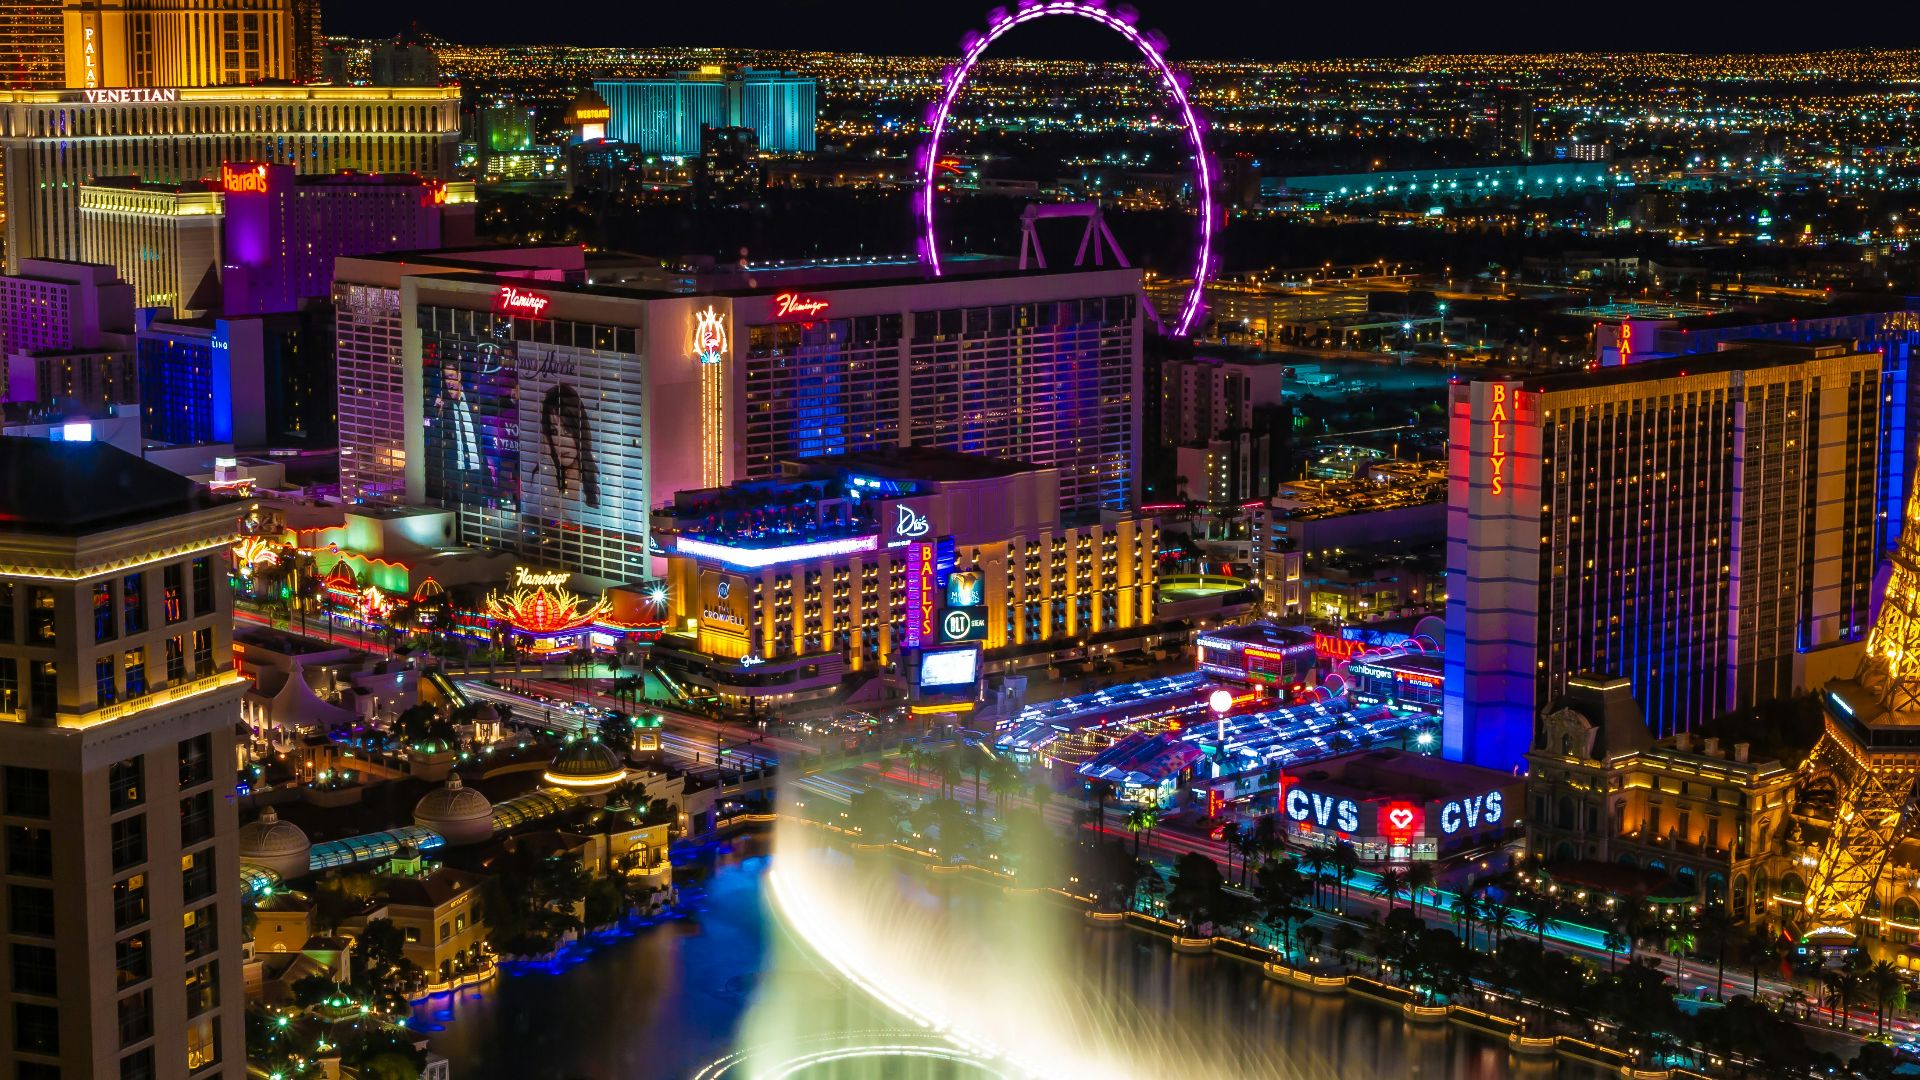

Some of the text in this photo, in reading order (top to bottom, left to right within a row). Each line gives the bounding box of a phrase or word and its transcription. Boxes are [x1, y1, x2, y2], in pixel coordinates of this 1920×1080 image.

[85, 89, 175, 103] VENETIAN
[501, 287, 548, 315] Flamingo
[775, 293, 828, 316] Flamingo
[1490, 384, 1507, 495] BALLYS
[515, 566, 571, 591] Flamingo
[1315, 633, 1366, 657] BALLY'S
[1348, 664, 1392, 679] wahlburgers
[1286, 788, 1359, 832] CVS
[1441, 791, 1502, 833] CVS
